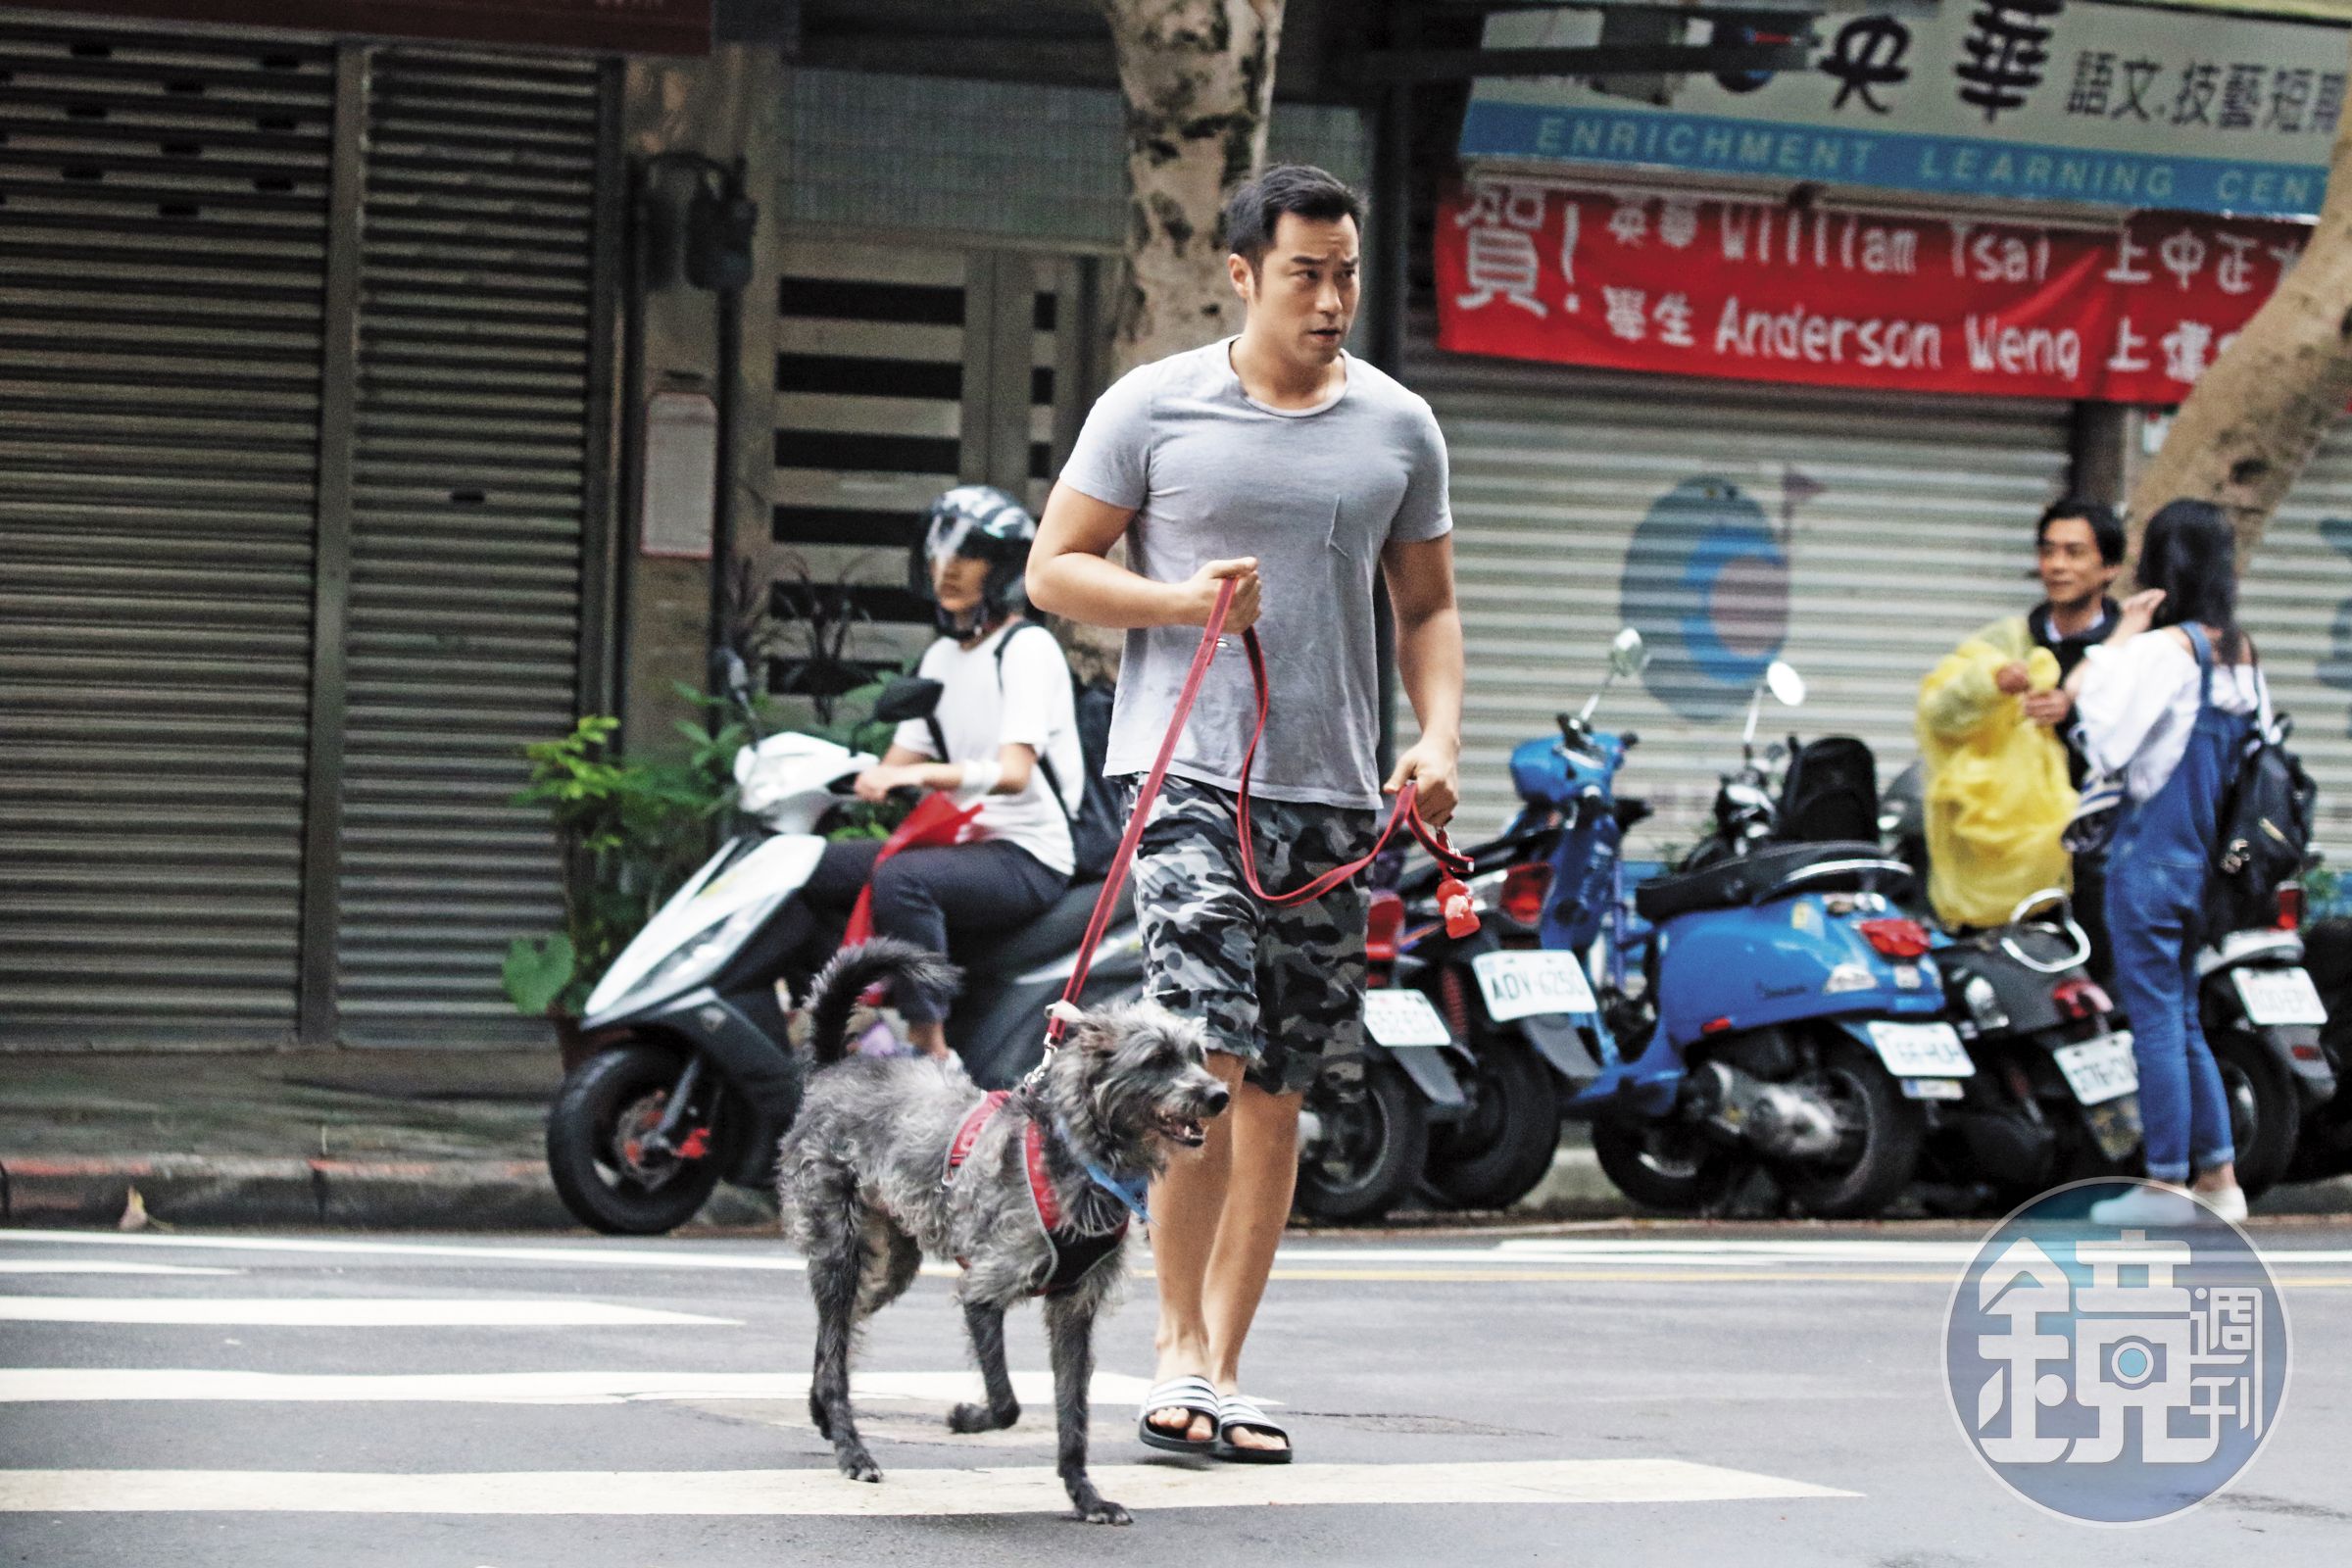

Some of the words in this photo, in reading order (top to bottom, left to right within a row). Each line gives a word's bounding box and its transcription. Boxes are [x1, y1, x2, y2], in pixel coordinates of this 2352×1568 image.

[1537, 116, 1878, 174] ENRICHMENT
[1918, 147, 2176, 198] LEARNING
[2218, 170, 2328, 205] CEN
[1715, 295, 1942, 370] Anderson
[1963, 313, 2082, 382] Weng
